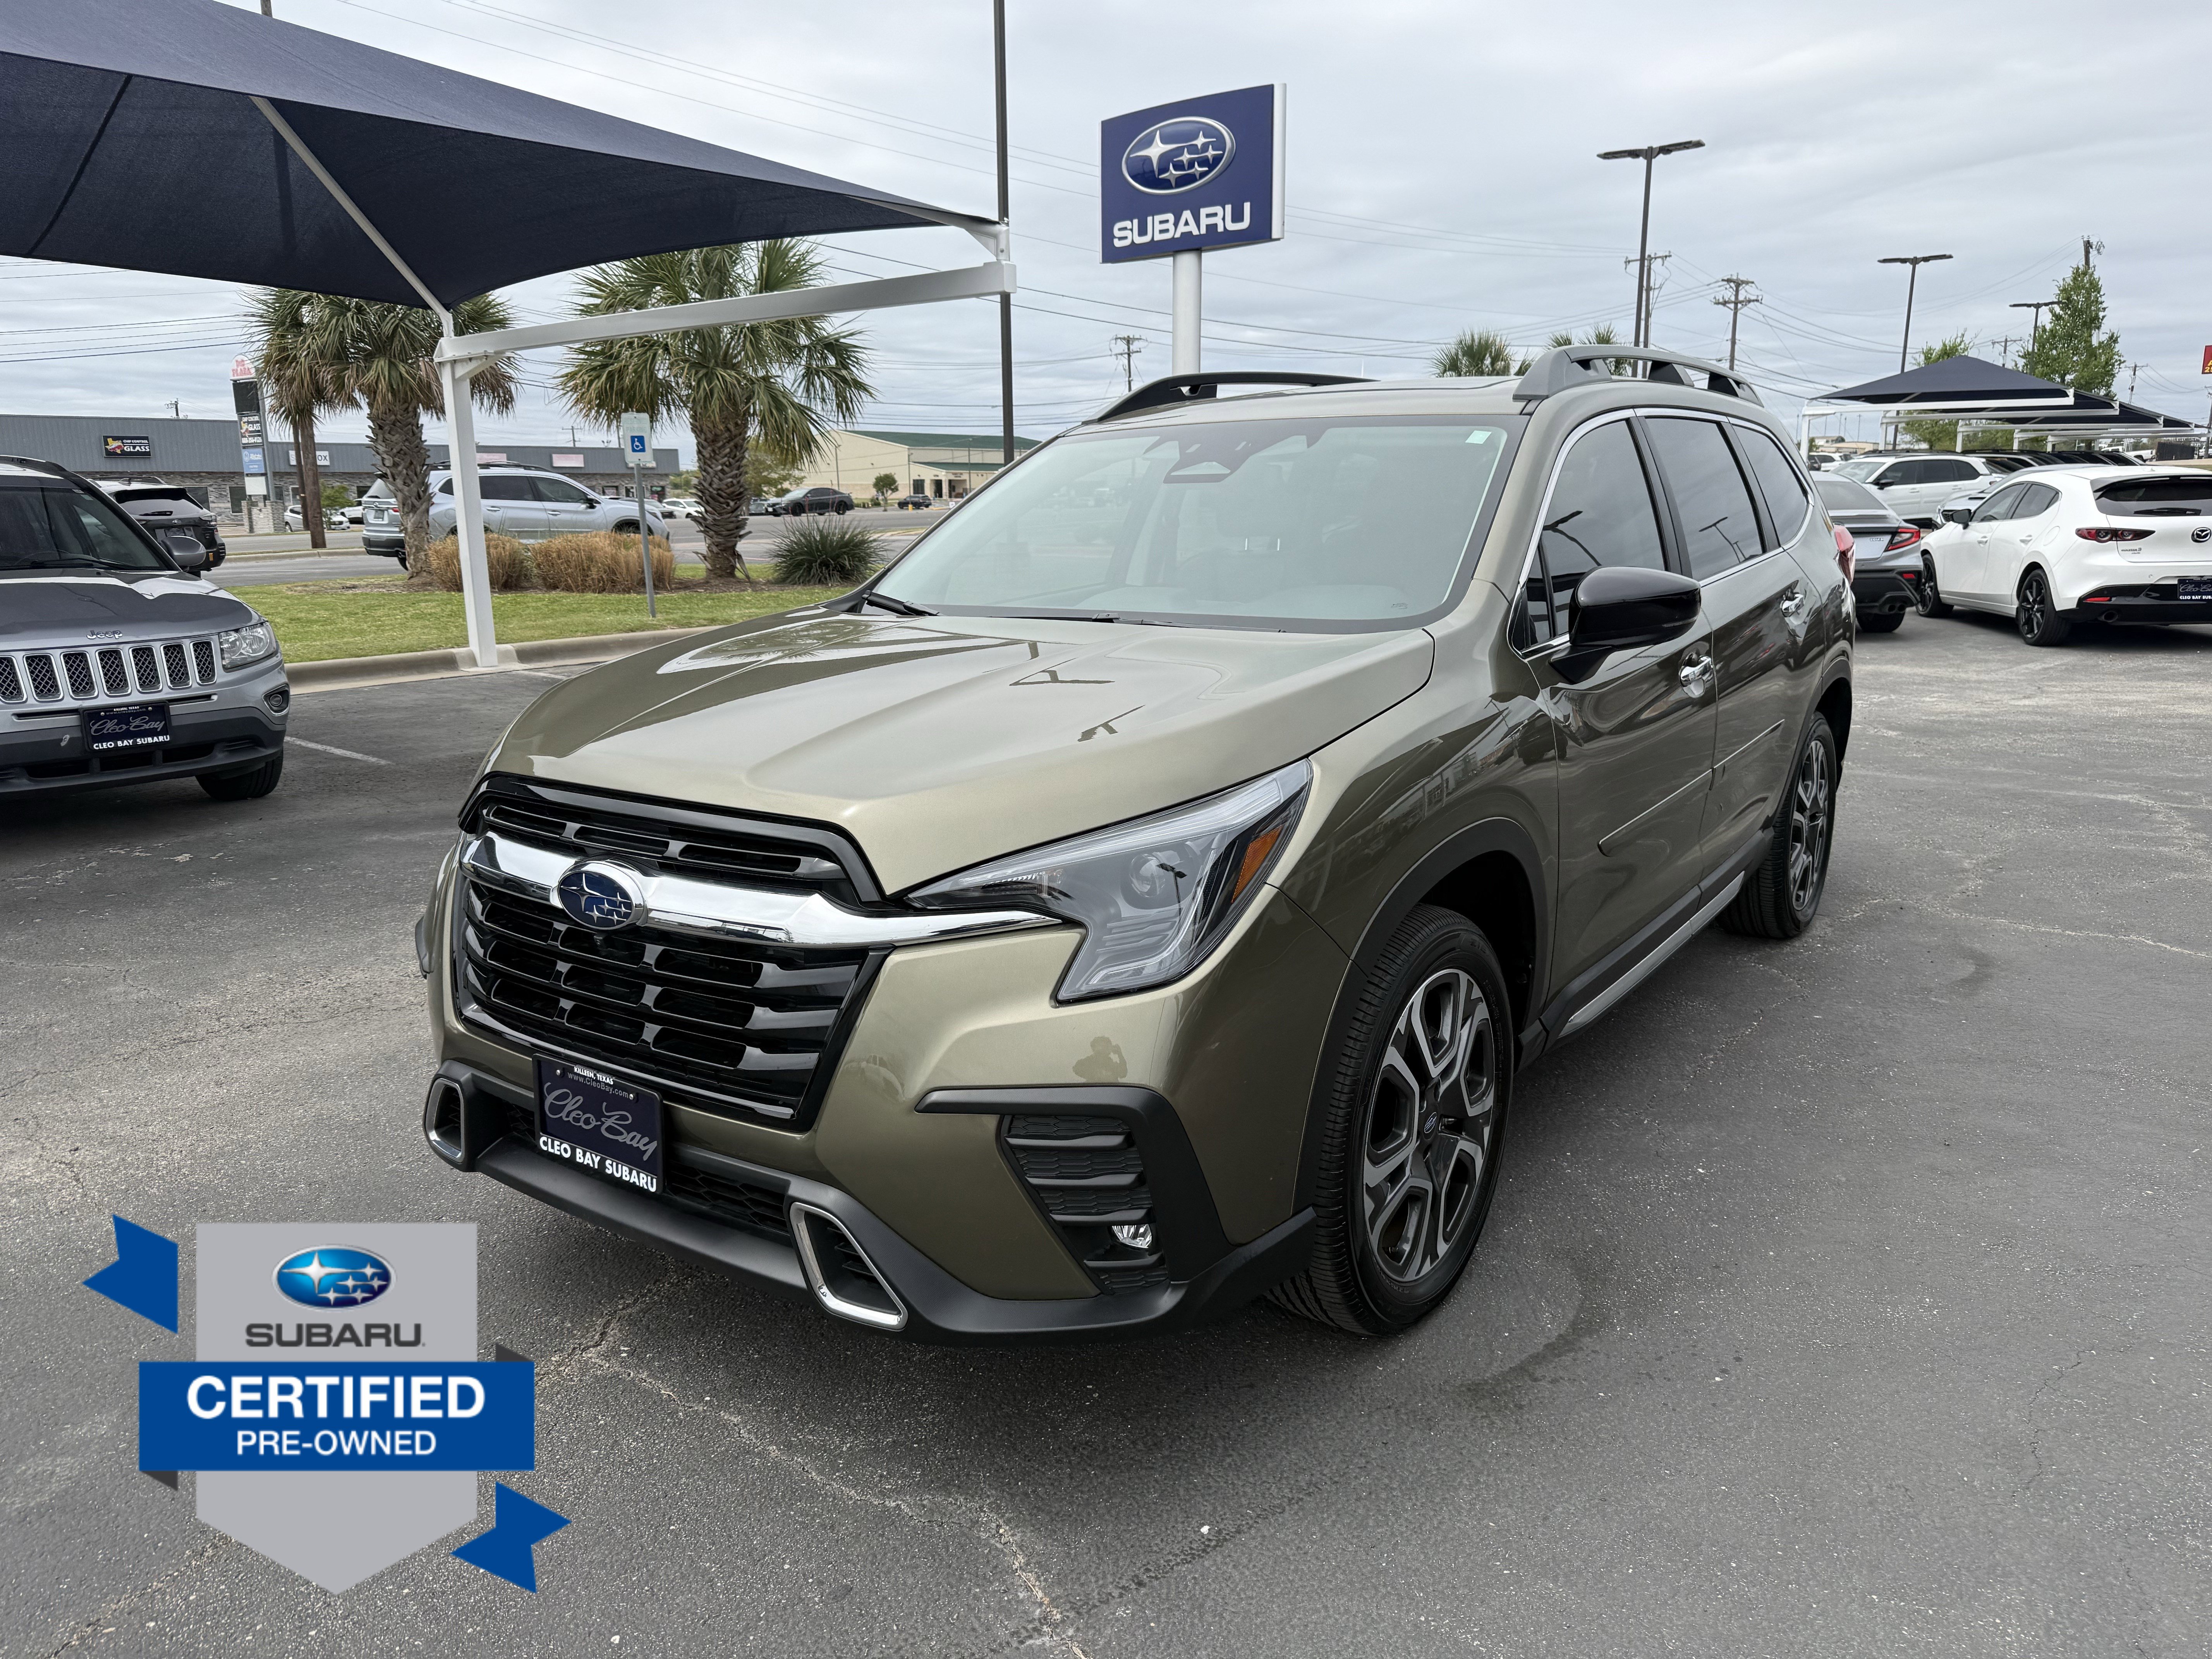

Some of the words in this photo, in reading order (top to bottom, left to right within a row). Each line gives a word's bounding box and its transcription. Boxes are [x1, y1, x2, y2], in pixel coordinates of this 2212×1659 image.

[1113, 201, 1251, 248] SUBARU
[86, 630, 123, 639] Jeep
[90, 719, 129, 735] Cleo
[129, 716, 165, 732] Bay
[137, 735, 170, 744] SUBARU
[568, 1072, 629, 1099] www.CleoBay.com
[574, 1066, 596, 1079] KILLEEN,
[596, 1074, 614, 1085] TEXAS
[544, 1082, 601, 1130] Cleo
[601, 1101, 658, 1161] Bay
[539, 1136, 571, 1158] CLEO
[576, 1148, 601, 1169] BAY
[605, 1159, 656, 1192] SUBARU
